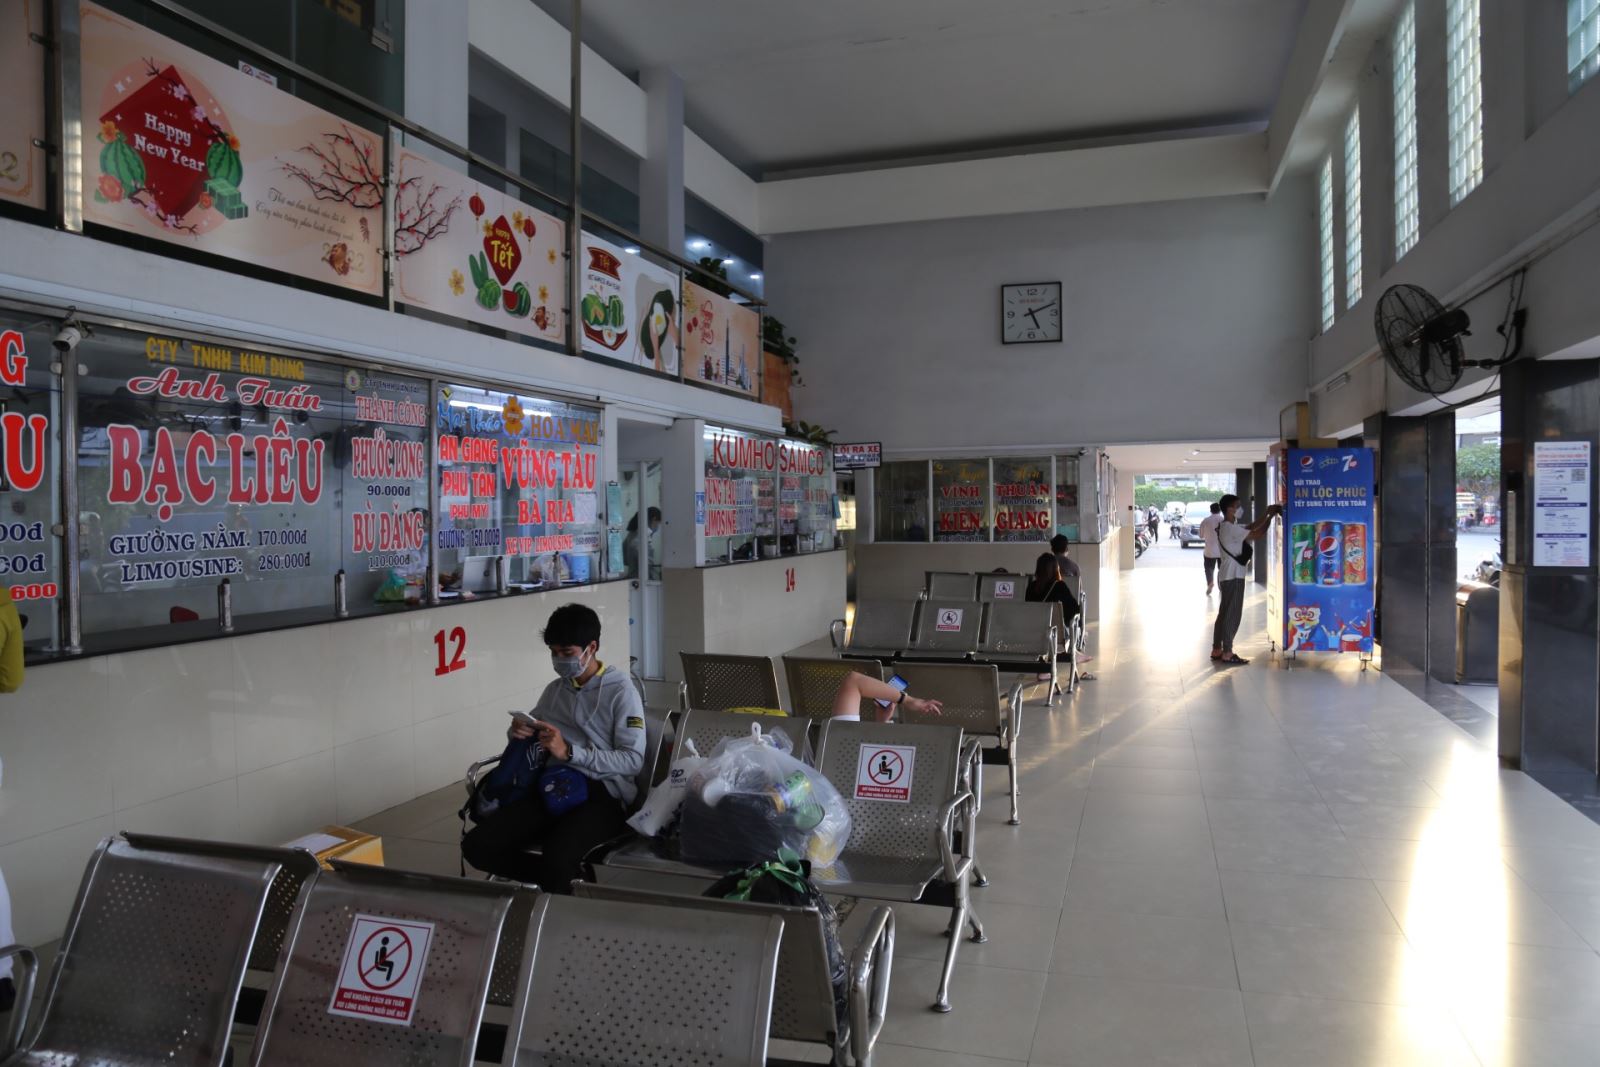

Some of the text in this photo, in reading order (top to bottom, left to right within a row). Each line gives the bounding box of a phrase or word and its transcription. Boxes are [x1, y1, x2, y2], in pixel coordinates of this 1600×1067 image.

[145, 113, 191, 147] Happy
[133, 134, 205, 172] New Year
[491, 240, 514, 270] Tết
[145, 337, 305, 380] CTY TNHH KIM DUNG
[127, 367, 324, 411] Anh Tuấn
[530, 415, 564, 439] HOA
[394, 440, 424, 480] LONG
[439, 435, 498, 464] AN GIANG
[501, 439, 596, 490] VŨNG TÀU
[713, 433, 824, 475] KUMHO SAMCO
[852, 446, 865, 454] RA
[868, 445, 880, 453] XE
[107, 416, 325, 521] BẠC LIÊU
[352, 500, 376, 553] BÙ
[518, 494, 575, 529] BÀ RỊA
[996, 511, 1049, 530] GIANG
[257, 529, 307, 546] 170.000đ
[121, 552, 311, 583] LIMOUSINE: 280.000đ
[785, 567, 796, 592] 14
[9, 583, 57, 600] 600
[434, 626, 467, 676] 12
